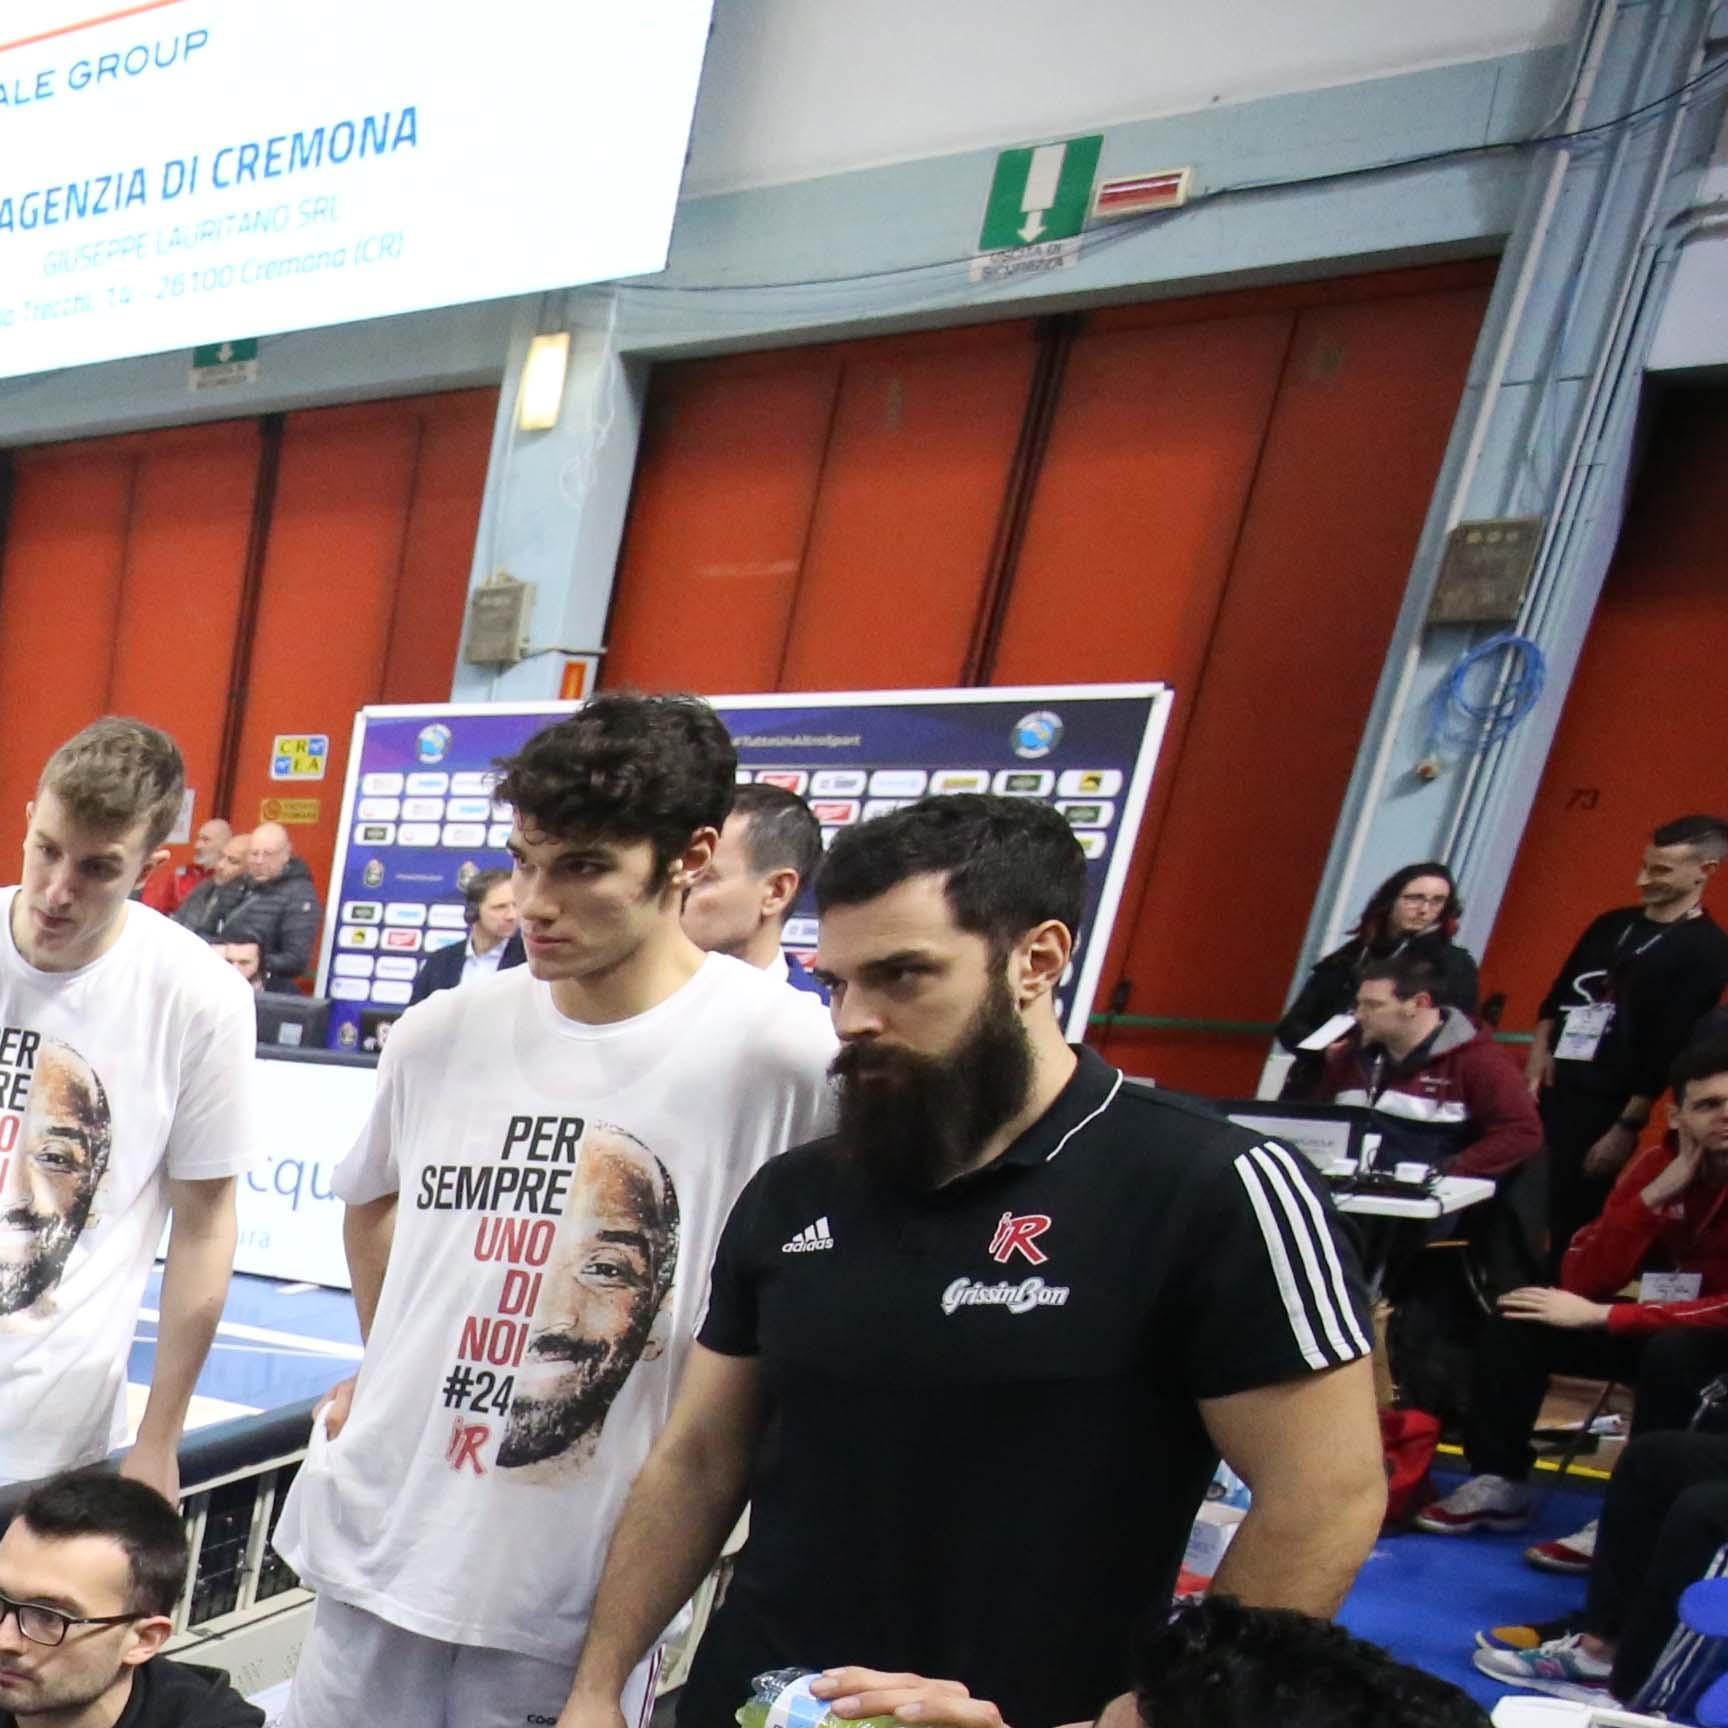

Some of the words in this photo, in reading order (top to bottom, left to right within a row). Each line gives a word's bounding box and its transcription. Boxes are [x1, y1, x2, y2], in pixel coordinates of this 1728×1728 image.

[68, 28, 209, 91] GROUP
[161, 155, 198, 200] DI
[212, 105, 417, 189] CREMONA
[43, 233, 144, 278] GIUSEPPE
[241, 246, 345, 286] Cremona
[1566, 789, 1599, 810] 73
[501, 1116, 585, 1164] PER
[247, 1155, 336, 1212] cqu
[417, 1165, 571, 1215] SEMPRE
[474, 1217, 556, 1264] UNO
[782, 1237, 834, 1253] adidas
[498, 1271, 542, 1318] DI
[941, 1275, 1070, 1314] GrissinBon
[458, 1317, 529, 1367] NOI
[443, 1365, 514, 1416] #24
